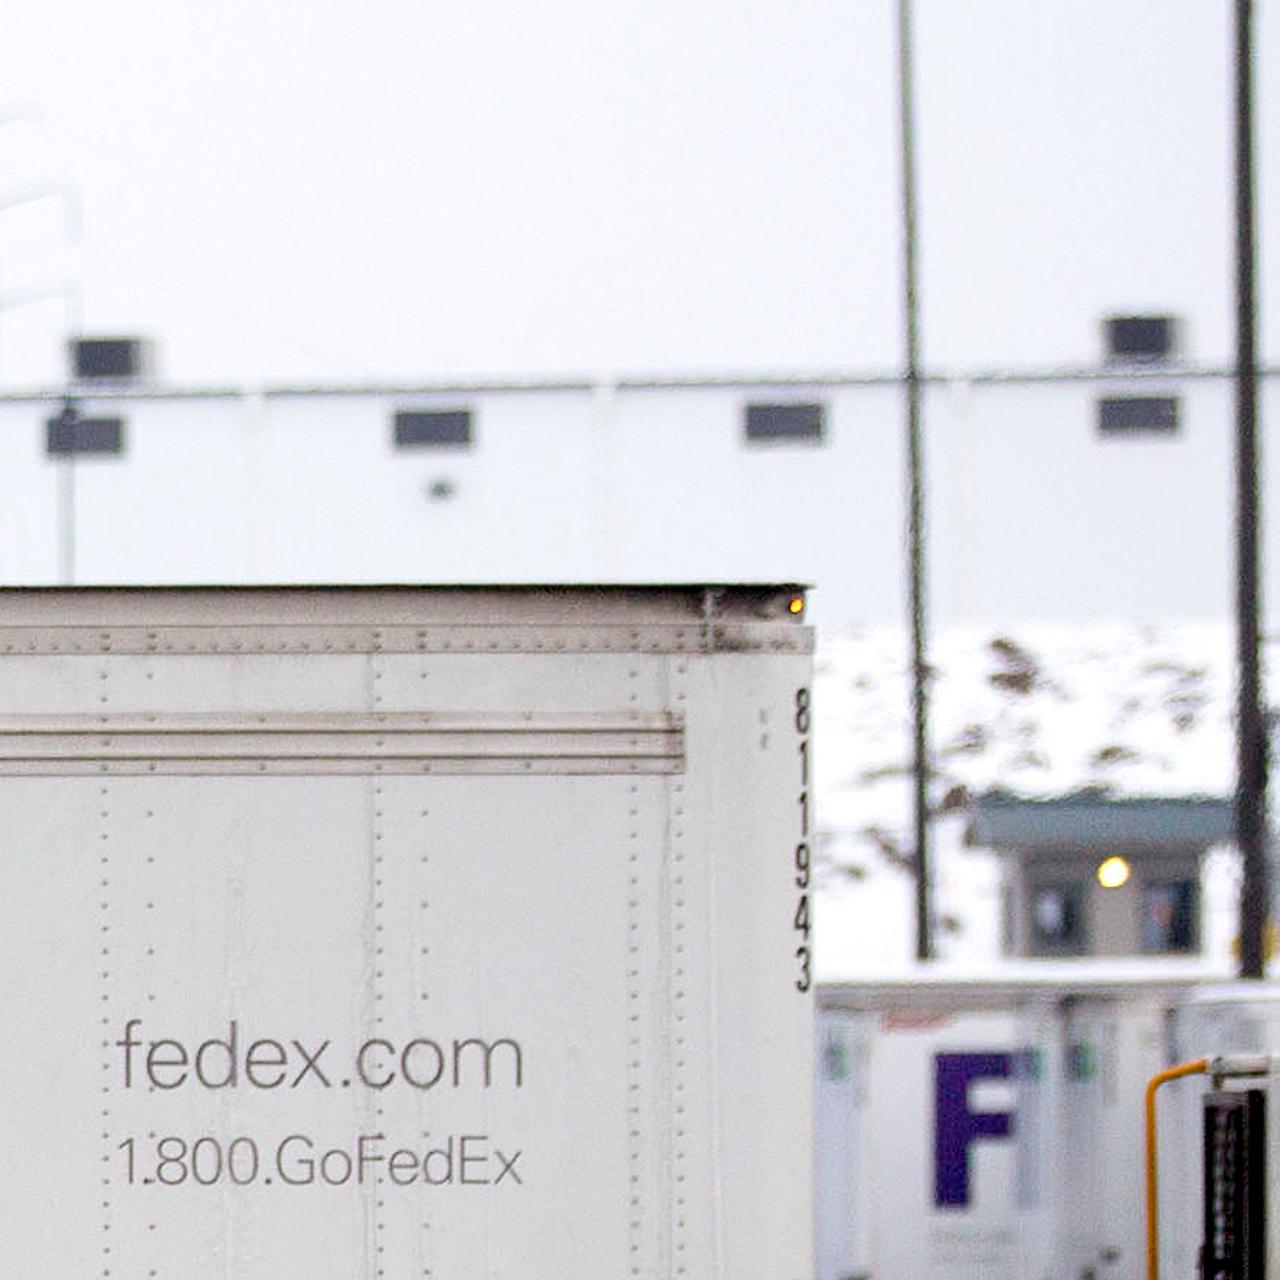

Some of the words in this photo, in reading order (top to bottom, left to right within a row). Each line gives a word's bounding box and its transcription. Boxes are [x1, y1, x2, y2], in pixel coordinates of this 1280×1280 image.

[794, 686, 811, 994] 811943
[115, 1018, 524, 1090] fedex.com
[116, 1134, 524, 1186] 1.800.GoFedEx
